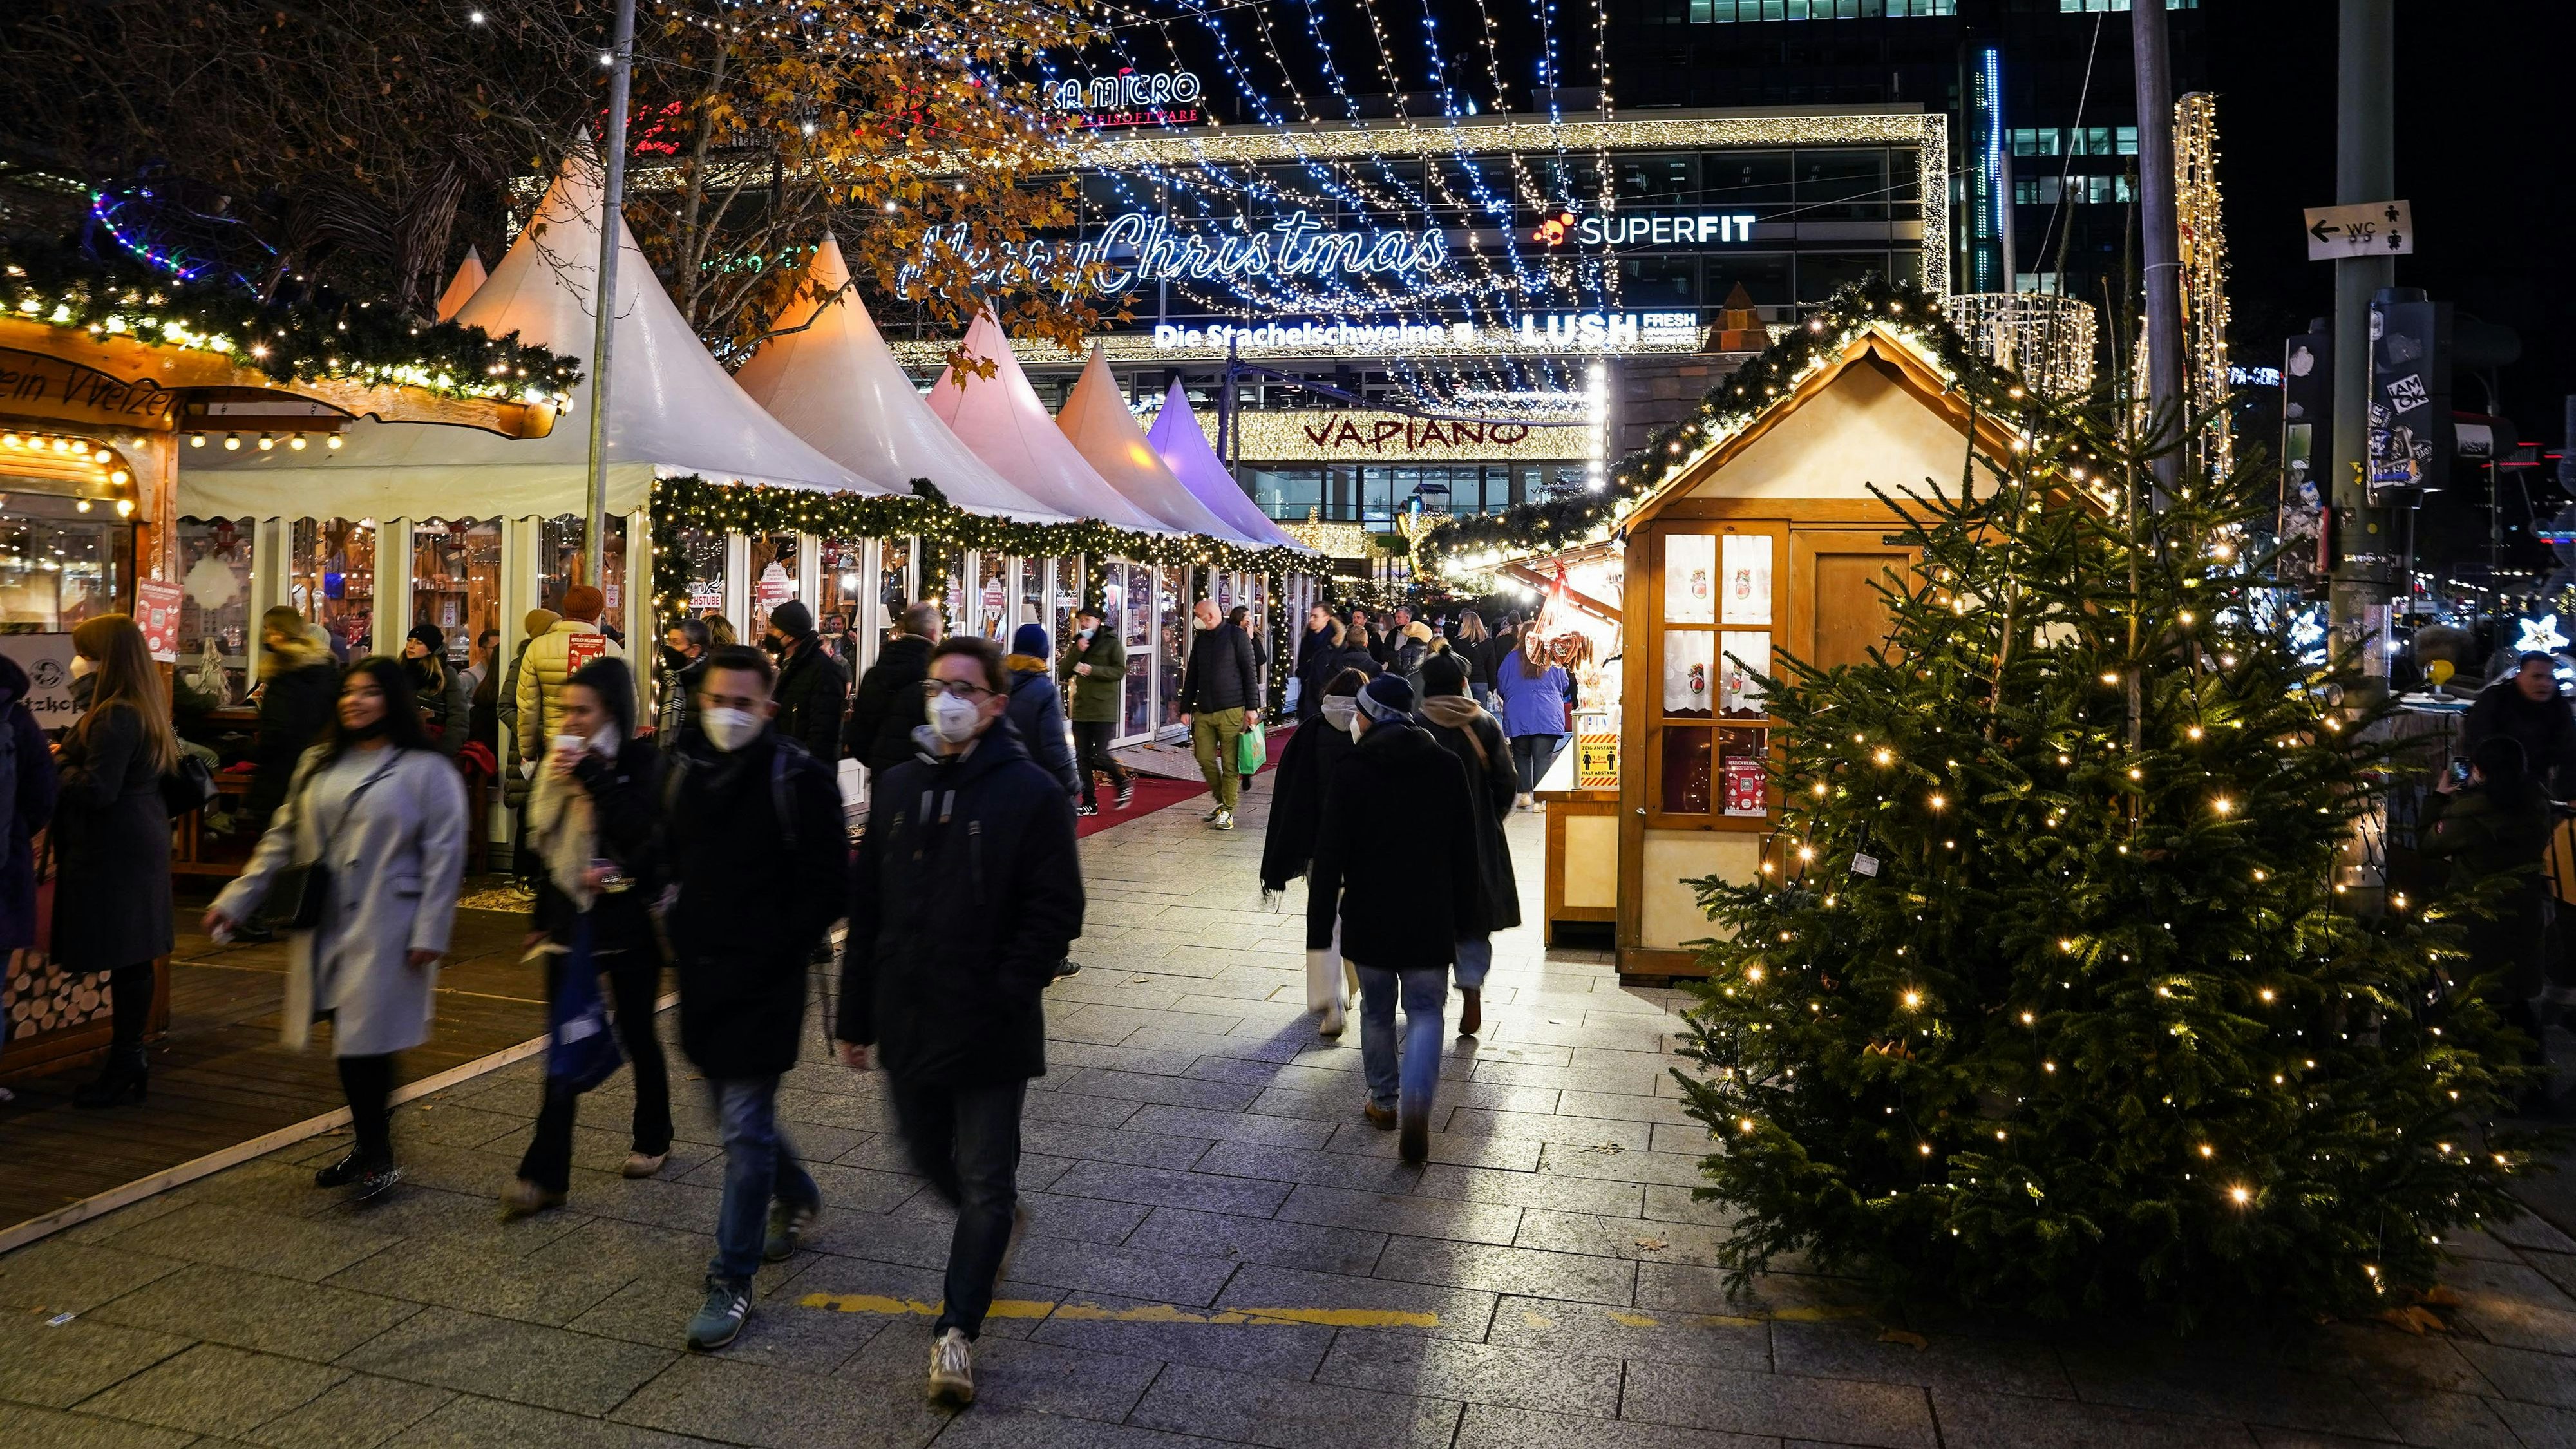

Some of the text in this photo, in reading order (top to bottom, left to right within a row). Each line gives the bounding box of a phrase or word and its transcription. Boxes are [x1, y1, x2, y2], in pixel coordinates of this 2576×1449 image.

[1582, 215, 1756, 245] SUPERFIT
[2345, 222, 2376, 235] WC
[1091, 210, 1444, 296] Christmas
[1155, 321, 1445, 348] Die Stachelschweine
[1522, 313, 1696, 346] LUSH FRESH
[2399, 389, 2427, 408] OK
[1305, 413, 1528, 453] VAPIANO
[690, 596, 719, 605] CHSTUBE
